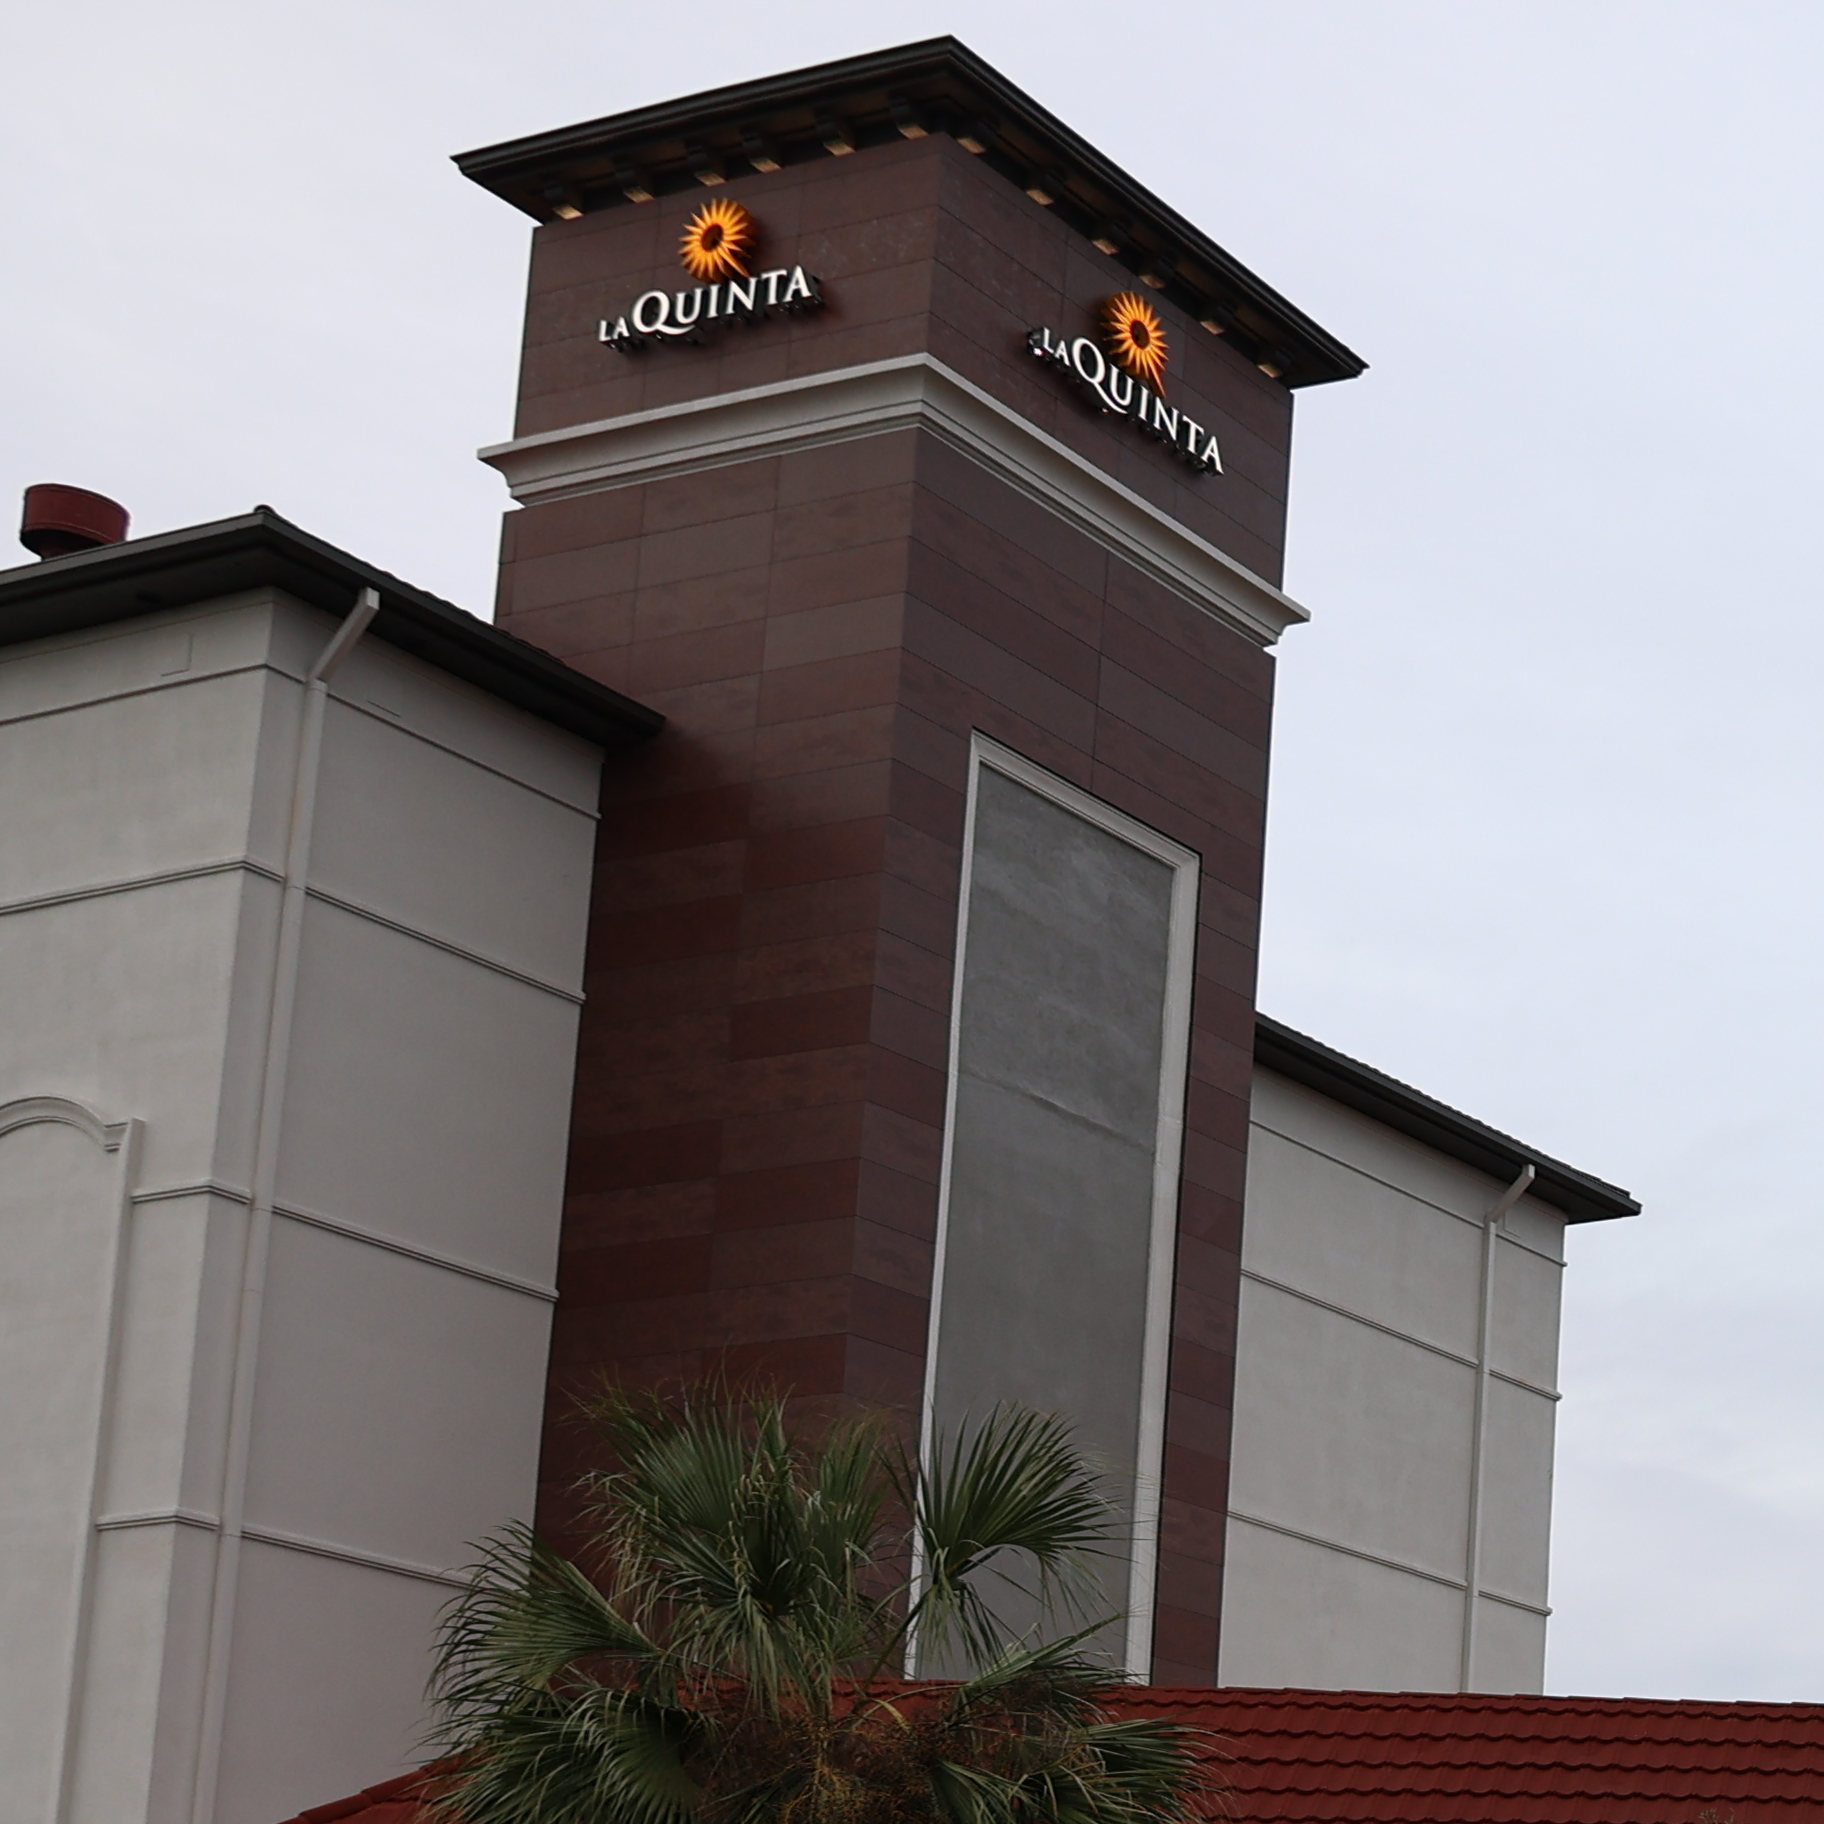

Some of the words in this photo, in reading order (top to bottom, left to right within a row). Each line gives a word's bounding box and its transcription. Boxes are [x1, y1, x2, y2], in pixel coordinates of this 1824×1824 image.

[598, 315, 631, 343] LA
[631, 264, 812, 336] QUINTA
[1042, 326, 1072, 368] LA
[1071, 337, 1225, 475] QUINTA
